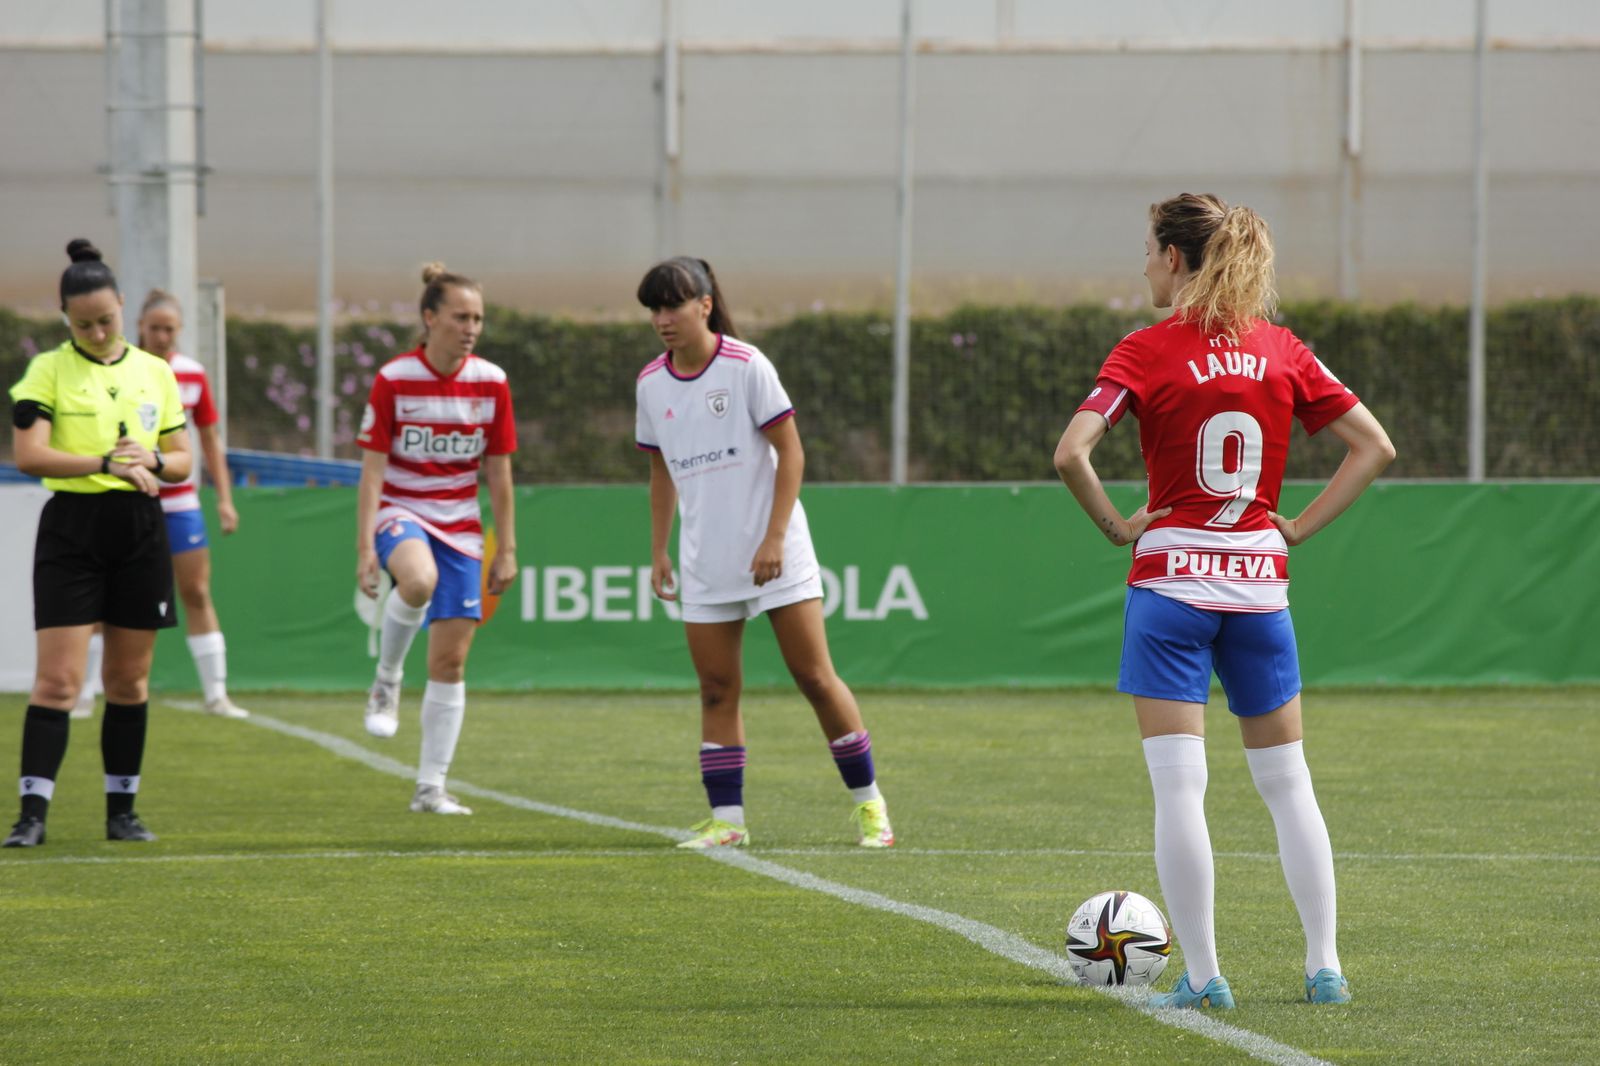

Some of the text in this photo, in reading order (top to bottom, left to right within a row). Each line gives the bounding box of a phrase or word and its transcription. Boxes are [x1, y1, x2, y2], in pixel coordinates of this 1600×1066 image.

[1187, 351, 1267, 385] LAURI
[403, 428, 484, 455] Platzi
[1196, 411, 1263, 528] 9
[1166, 551, 1278, 578] PULEVA
[520, 565, 929, 620] IBERLA
